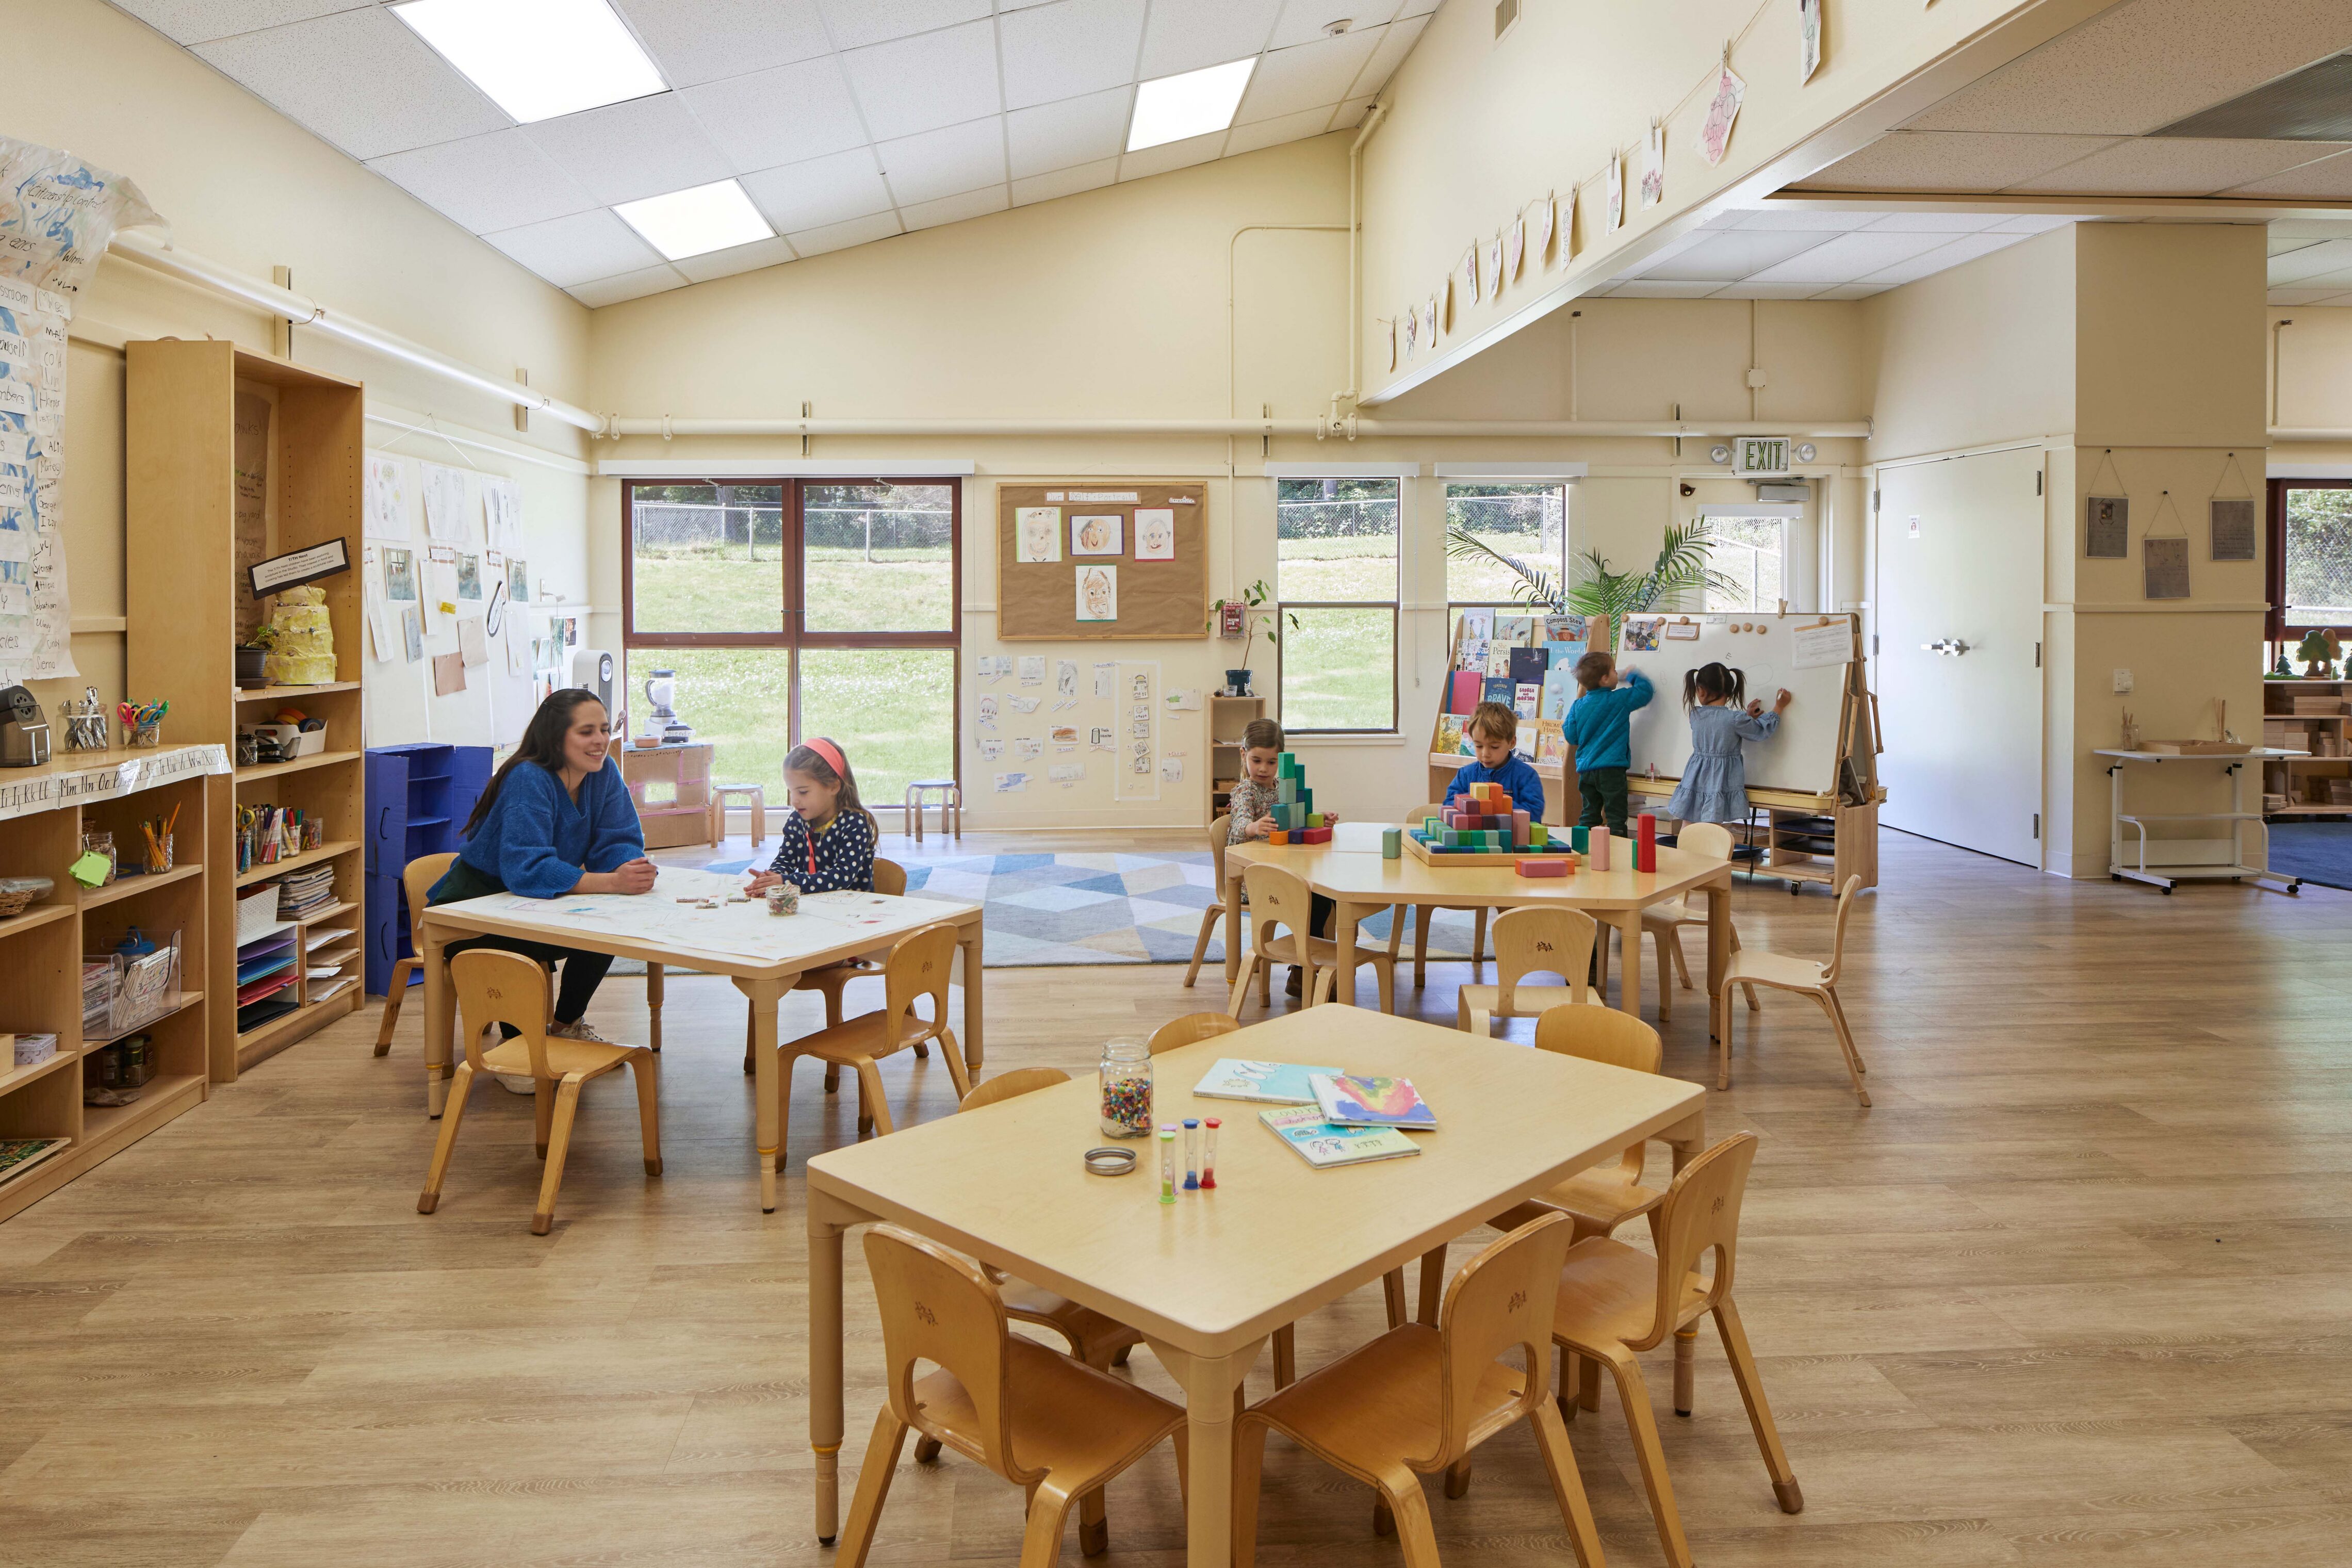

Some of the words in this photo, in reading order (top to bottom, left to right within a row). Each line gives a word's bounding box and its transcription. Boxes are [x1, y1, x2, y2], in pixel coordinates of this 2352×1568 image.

[1746, 442, 1783, 469] EXIT
[12, 787, 21, 812] Jj
[25, 784, 35, 803] Kk
[60, 778, 77, 797] Mm
[81, 775, 94, 793] Nn
[99, 773, 110, 791] Oo
